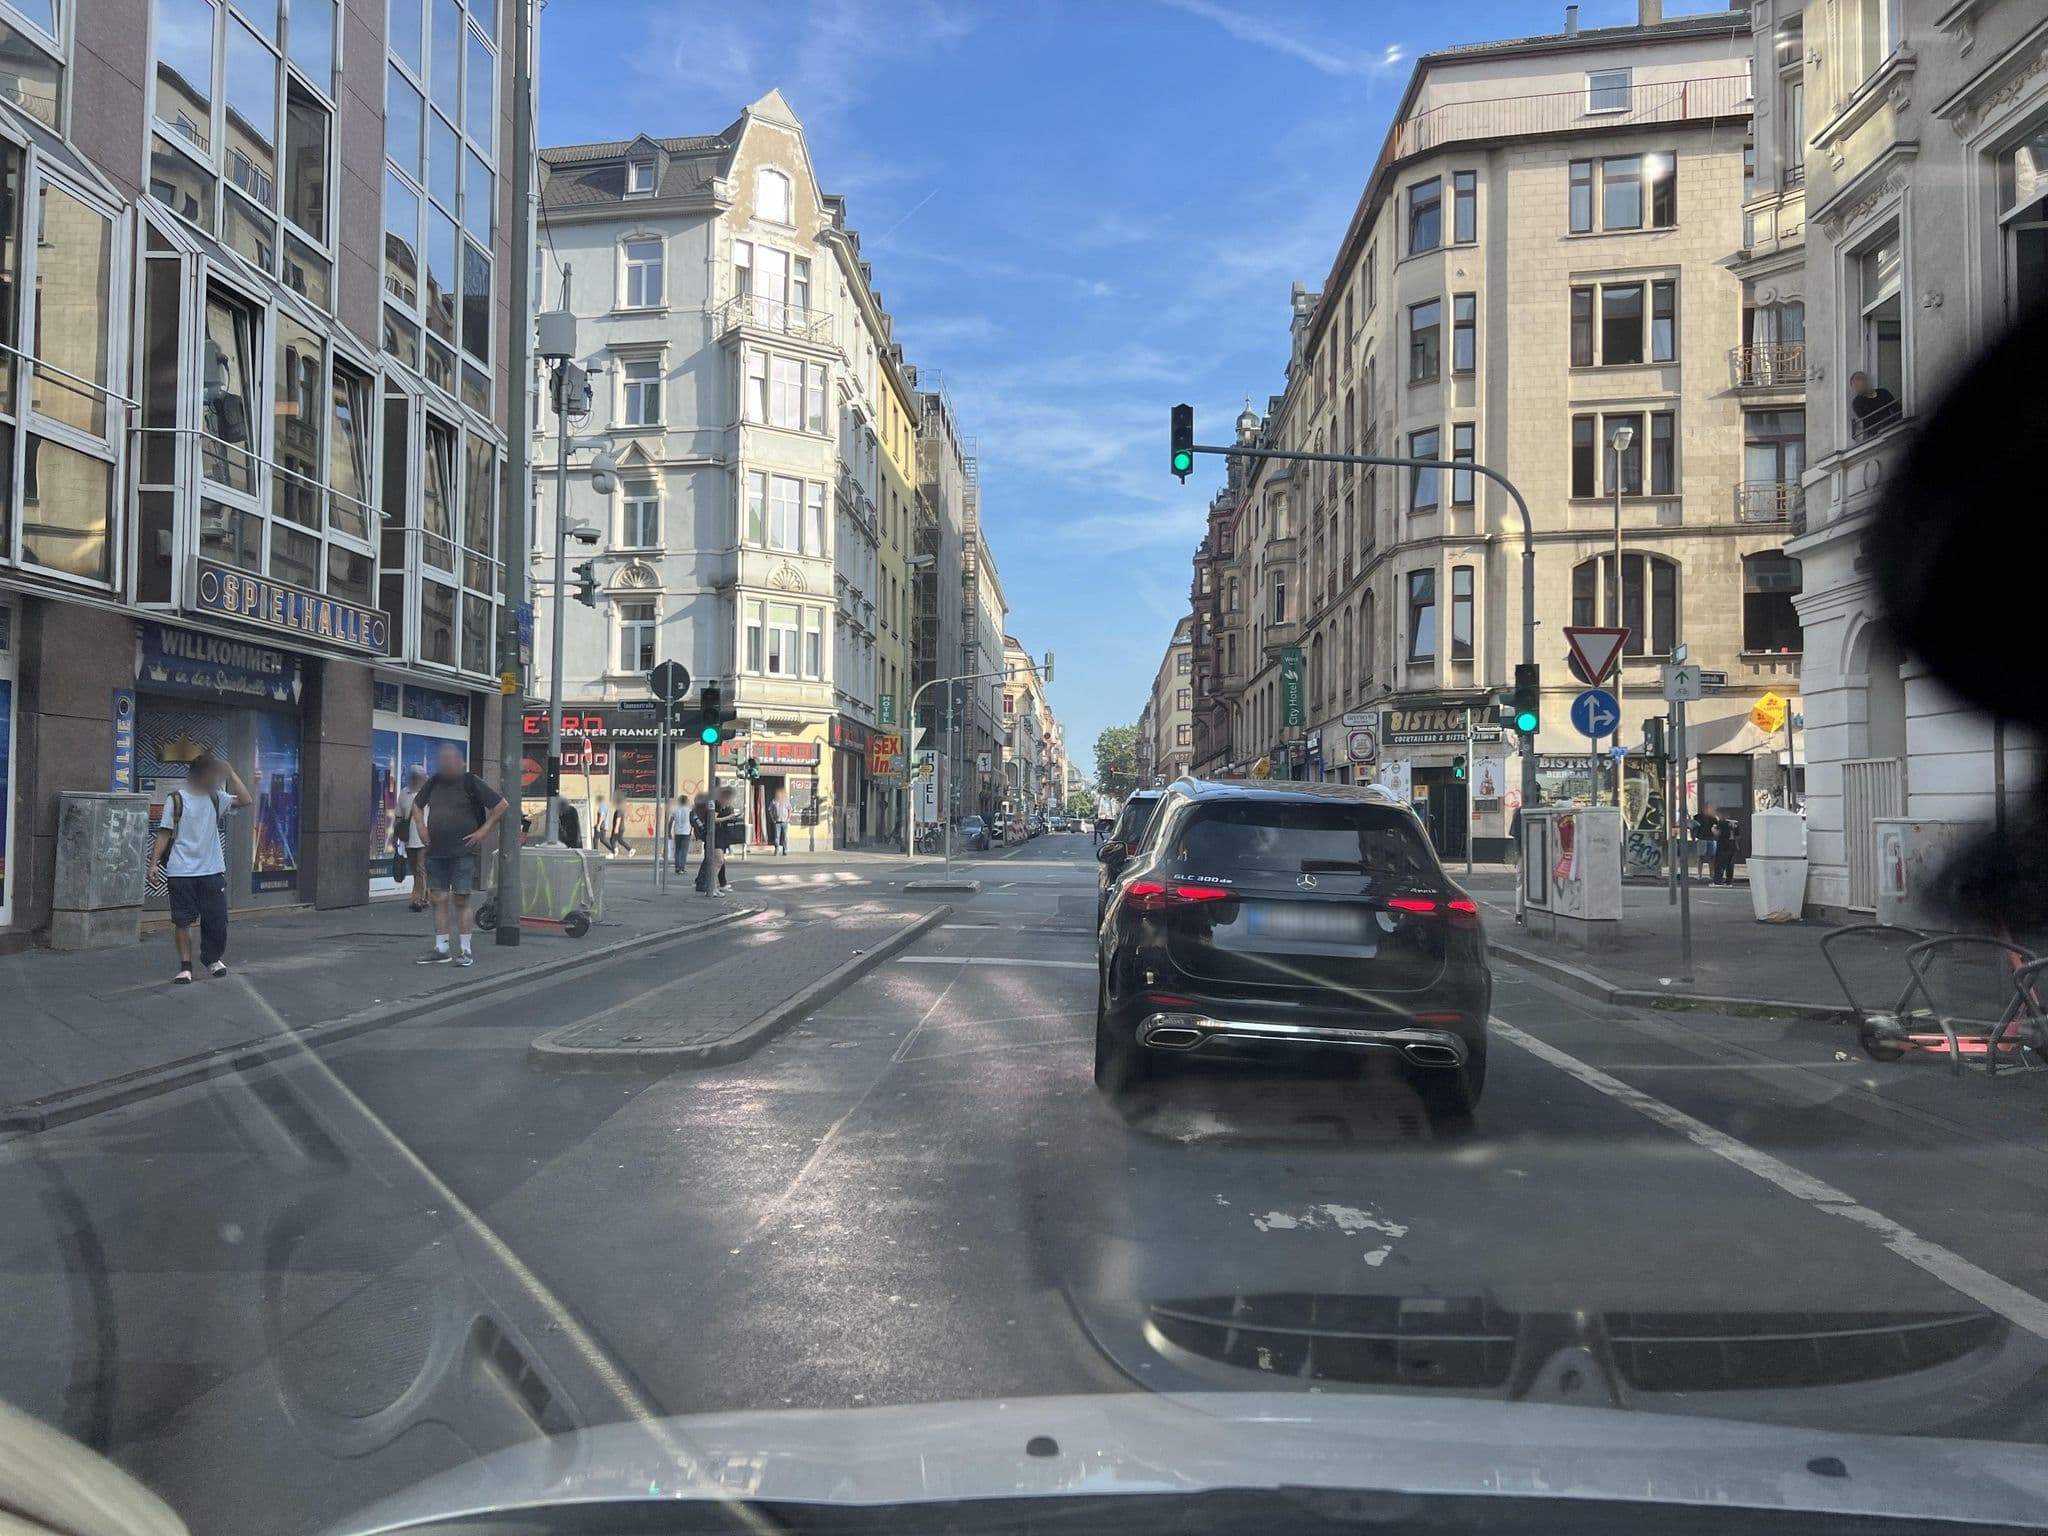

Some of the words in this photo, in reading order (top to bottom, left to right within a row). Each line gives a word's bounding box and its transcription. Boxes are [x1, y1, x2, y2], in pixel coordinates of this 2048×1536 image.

[223, 574, 371, 646] SPIELHALLE
[161, 628, 283, 674] WILLKOMMEN
[1288, 682, 1297, 706] Hotel
[882, 696, 890, 723] HOTEL
[1289, 707, 1300, 726] City
[1391, 708, 1460, 731] BISTRO
[116, 719, 130, 792] ALLE
[874, 737, 898, 755] SEX
[1539, 757, 1600, 769] BISTRO
[1173, 873, 1196, 881] GLC
